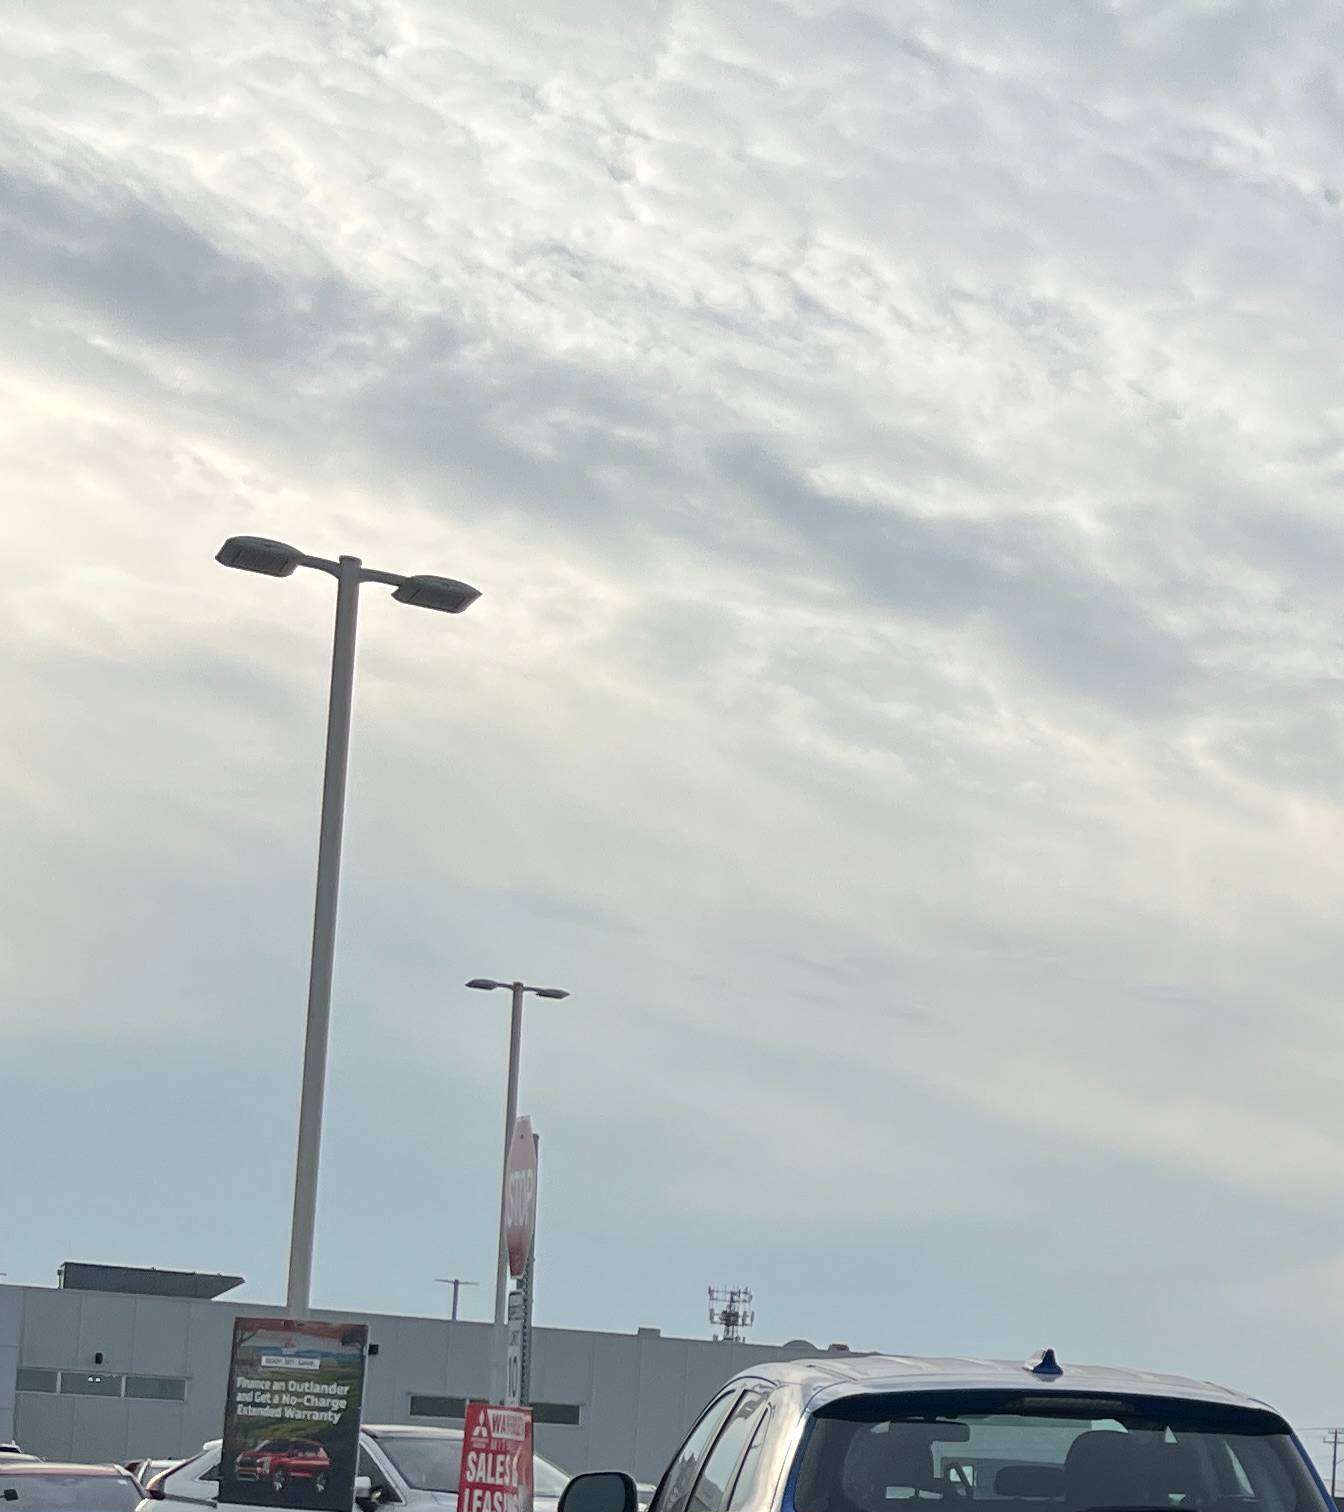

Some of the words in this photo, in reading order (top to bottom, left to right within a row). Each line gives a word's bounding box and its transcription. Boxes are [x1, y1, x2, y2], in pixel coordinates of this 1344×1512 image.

[236, 1377, 271, 1390] Finance
[272, 1381, 286, 1390] an
[288, 1381, 350, 1395] Outlander
[236, 1391, 253, 1402] and
[254, 1392, 271, 1404] Get
[282, 1394, 347, 1410] No-Charge
[237, 1404, 282, 1418] Extended
[284, 1408, 342, 1424] Warranty
